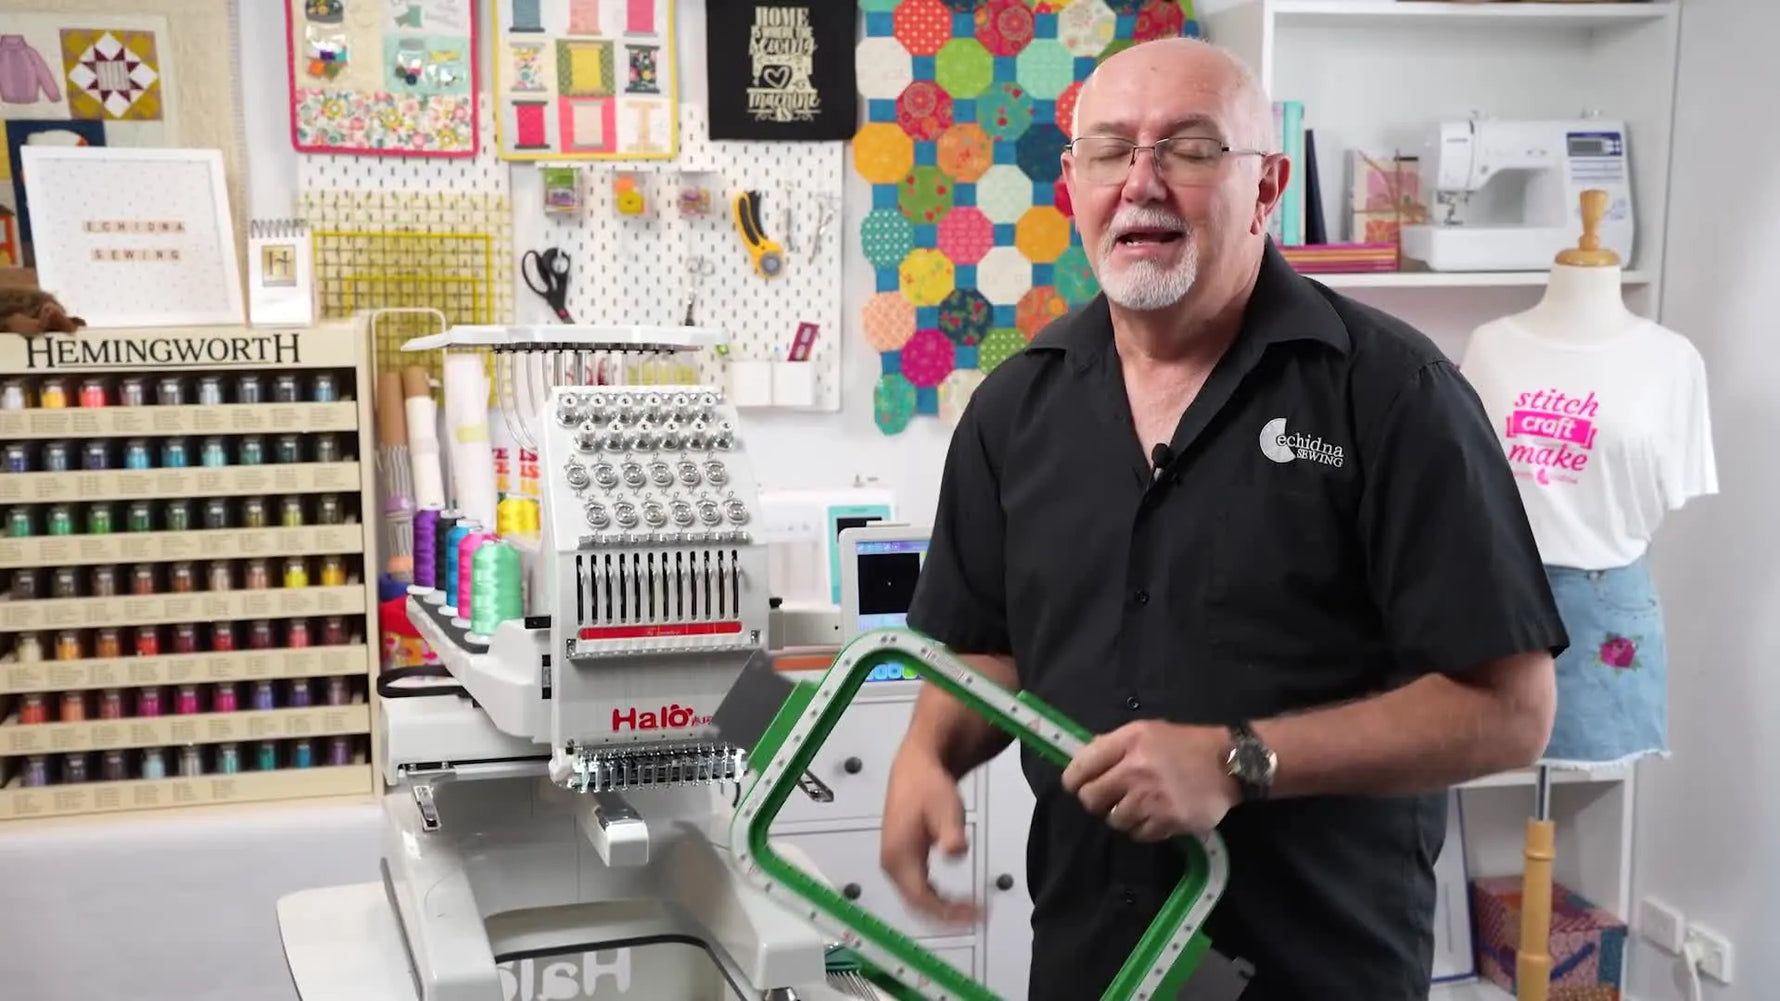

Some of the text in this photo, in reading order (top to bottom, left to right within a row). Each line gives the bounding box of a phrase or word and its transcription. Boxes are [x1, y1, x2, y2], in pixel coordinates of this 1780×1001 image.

[755, 6, 809, 27] HOME
[86, 221, 185, 232] ECHIDNA
[95, 249, 180, 261] SEWING
[26, 334, 301, 368] HEMINGWORTH
[1514, 389, 1599, 417] stitch
[1522, 416, 1577, 439] craft
[1277, 432, 1344, 457] echidna
[1297, 448, 1344, 468] SEWING
[1508, 443, 1588, 472] make
[612, 704, 693, 733] Halo
